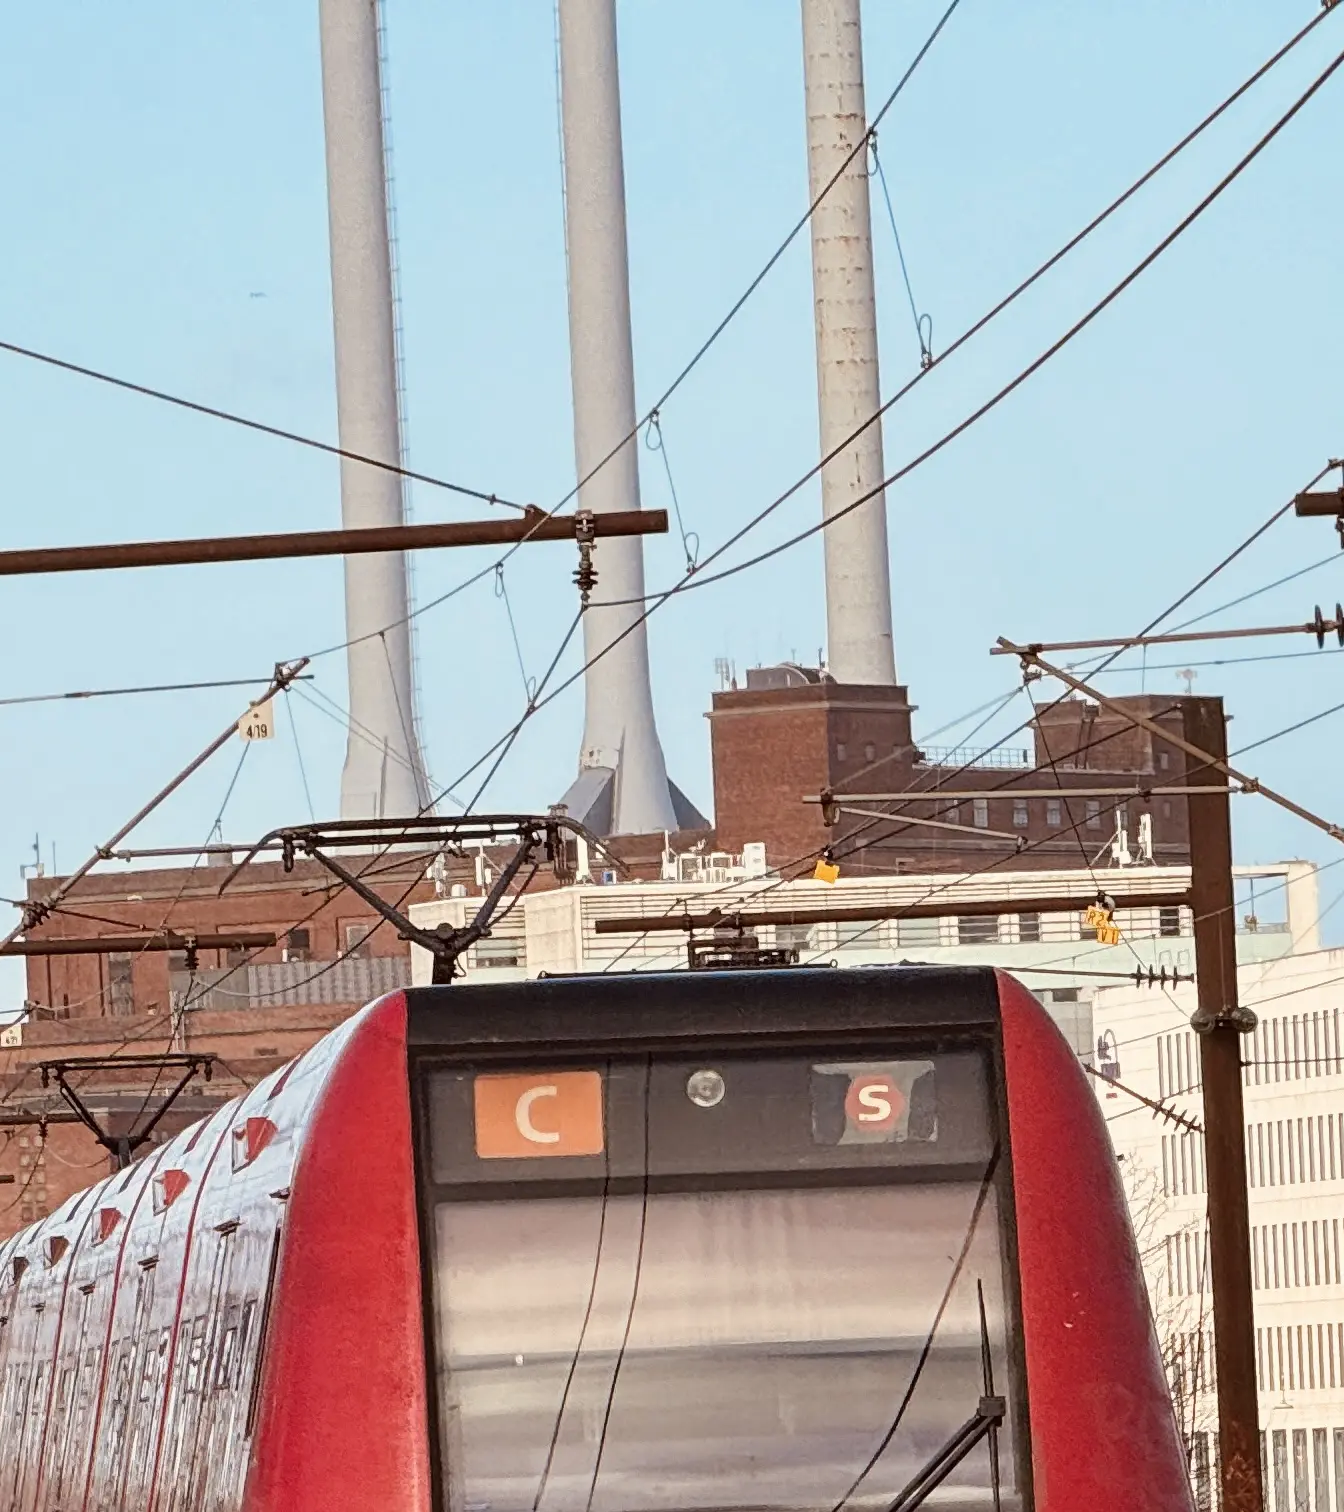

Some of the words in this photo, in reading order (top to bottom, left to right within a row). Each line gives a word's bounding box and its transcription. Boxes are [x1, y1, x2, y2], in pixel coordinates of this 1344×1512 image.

[246, 723, 268, 739] 4/19
[515, 1085, 560, 1144] C
[858, 1084, 892, 1123] S
